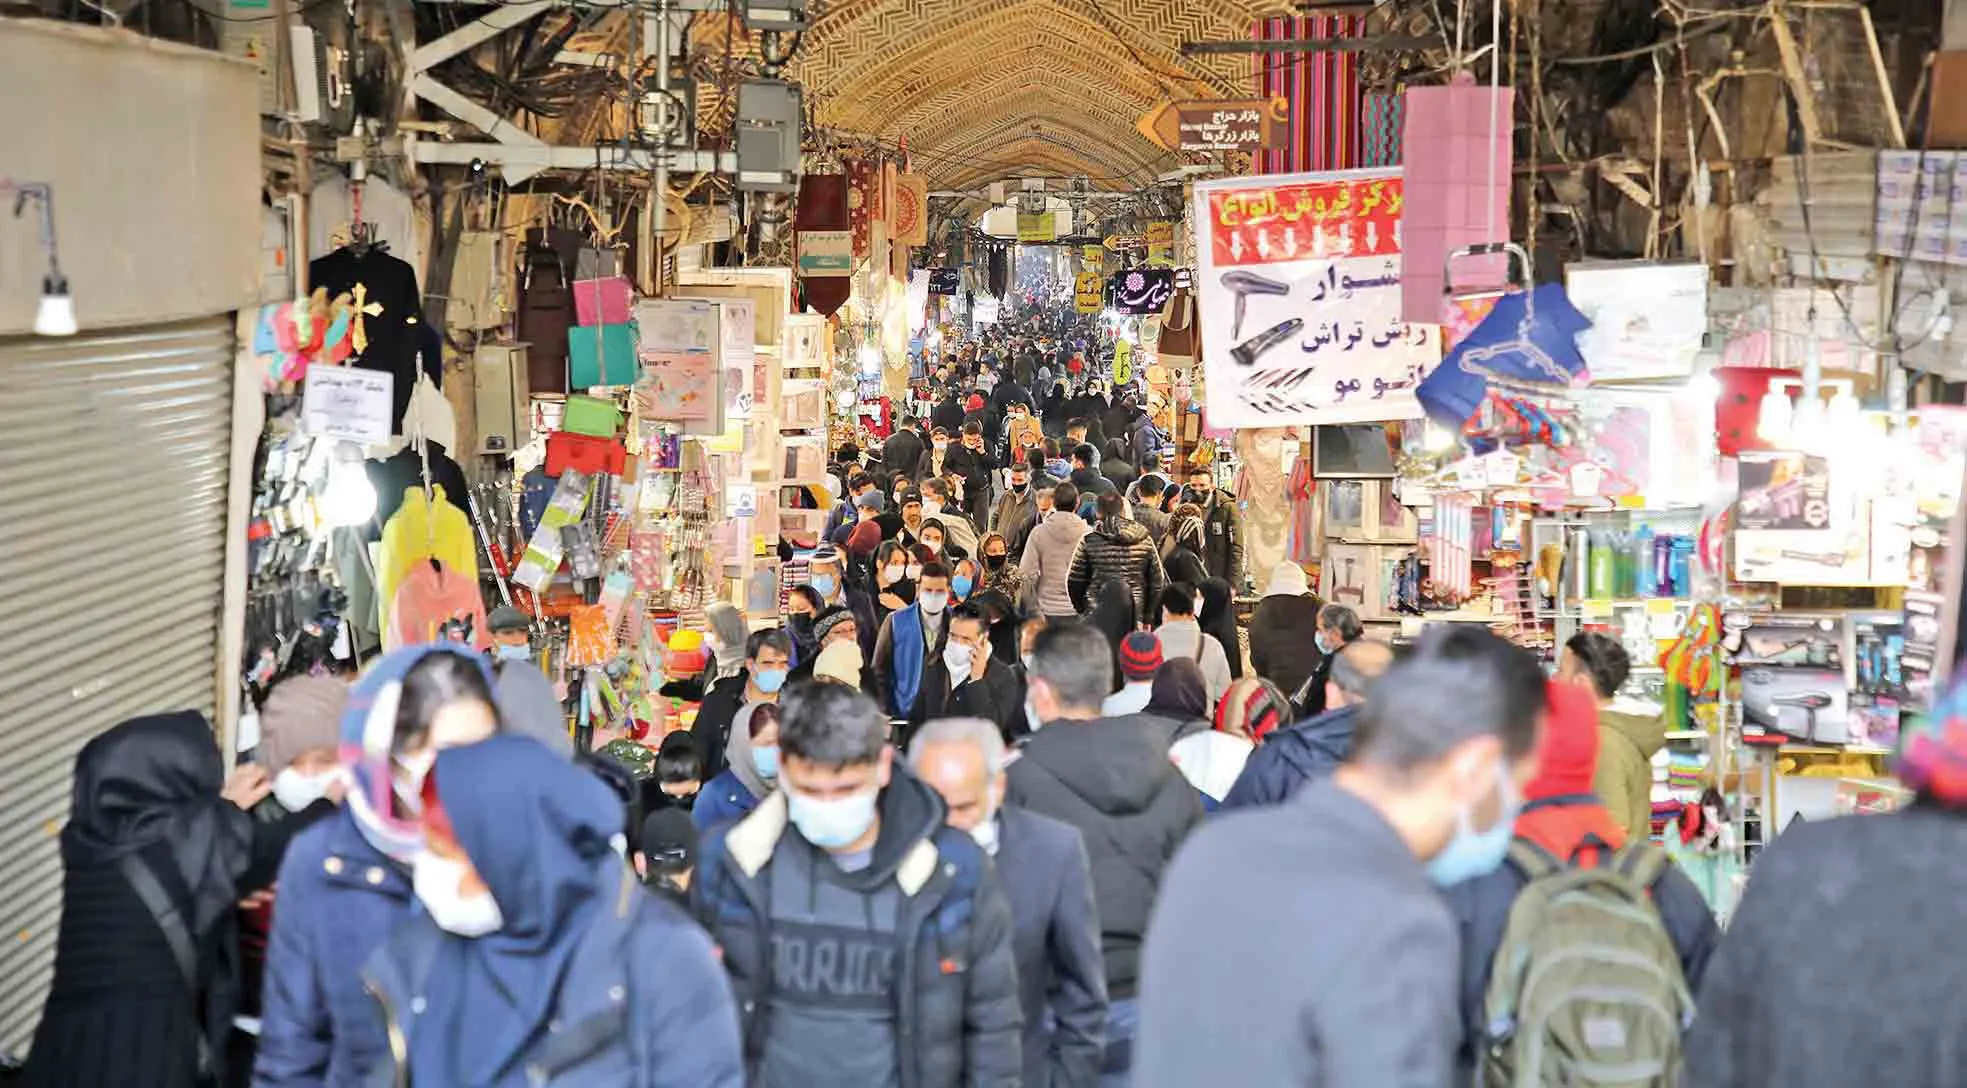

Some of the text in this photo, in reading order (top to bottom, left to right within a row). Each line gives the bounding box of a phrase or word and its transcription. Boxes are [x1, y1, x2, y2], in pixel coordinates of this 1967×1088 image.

[1212, 109, 1260, 125] بازار حراج
[1237, 129, 1260, 143] بازار
[1219, 190, 1277, 226] انواع
[1280, 183, 1351, 222] فروش
[1301, 321, 1364, 353] تراش
[1333, 377, 1362, 402] مو
